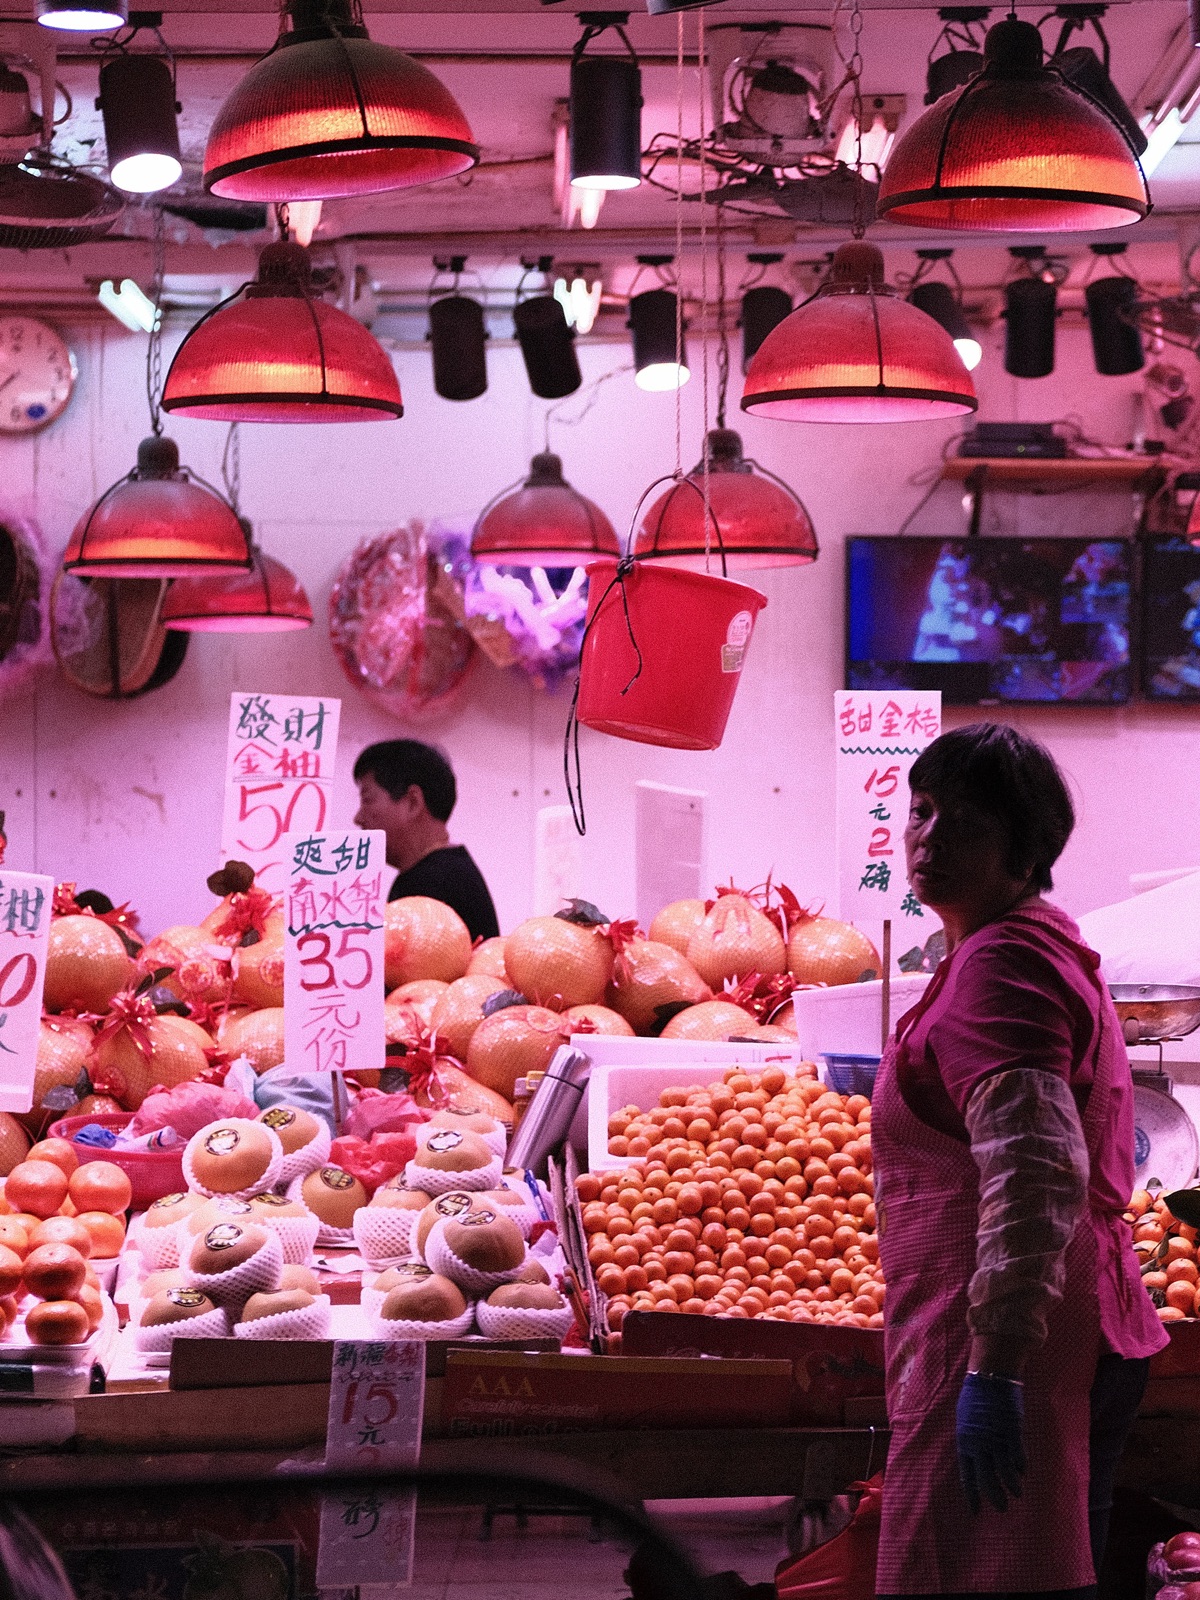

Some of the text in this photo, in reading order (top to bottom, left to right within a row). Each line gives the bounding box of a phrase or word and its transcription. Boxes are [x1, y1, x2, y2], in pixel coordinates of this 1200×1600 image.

[236, 695, 331, 750] 發財
[839, 698, 940, 738] 甜金桔
[863, 765, 901, 798] 15
[236, 782, 327, 852] 50
[868, 802, 892, 821] 元
[291, 834, 371, 876] 爽甜
[867, 826, 894, 857] 2
[858, 860, 892, 892] 磅
[0, 878, 45, 932] 柑
[297, 929, 373, 993] 35
[301, 994, 360, 1031] 元
[304, 1026, 356, 1072] 份
[342, 1382, 399, 1426] 15
[469, 1375, 536, 1397] AAA
[357, 1427, 386, 1446] 元
